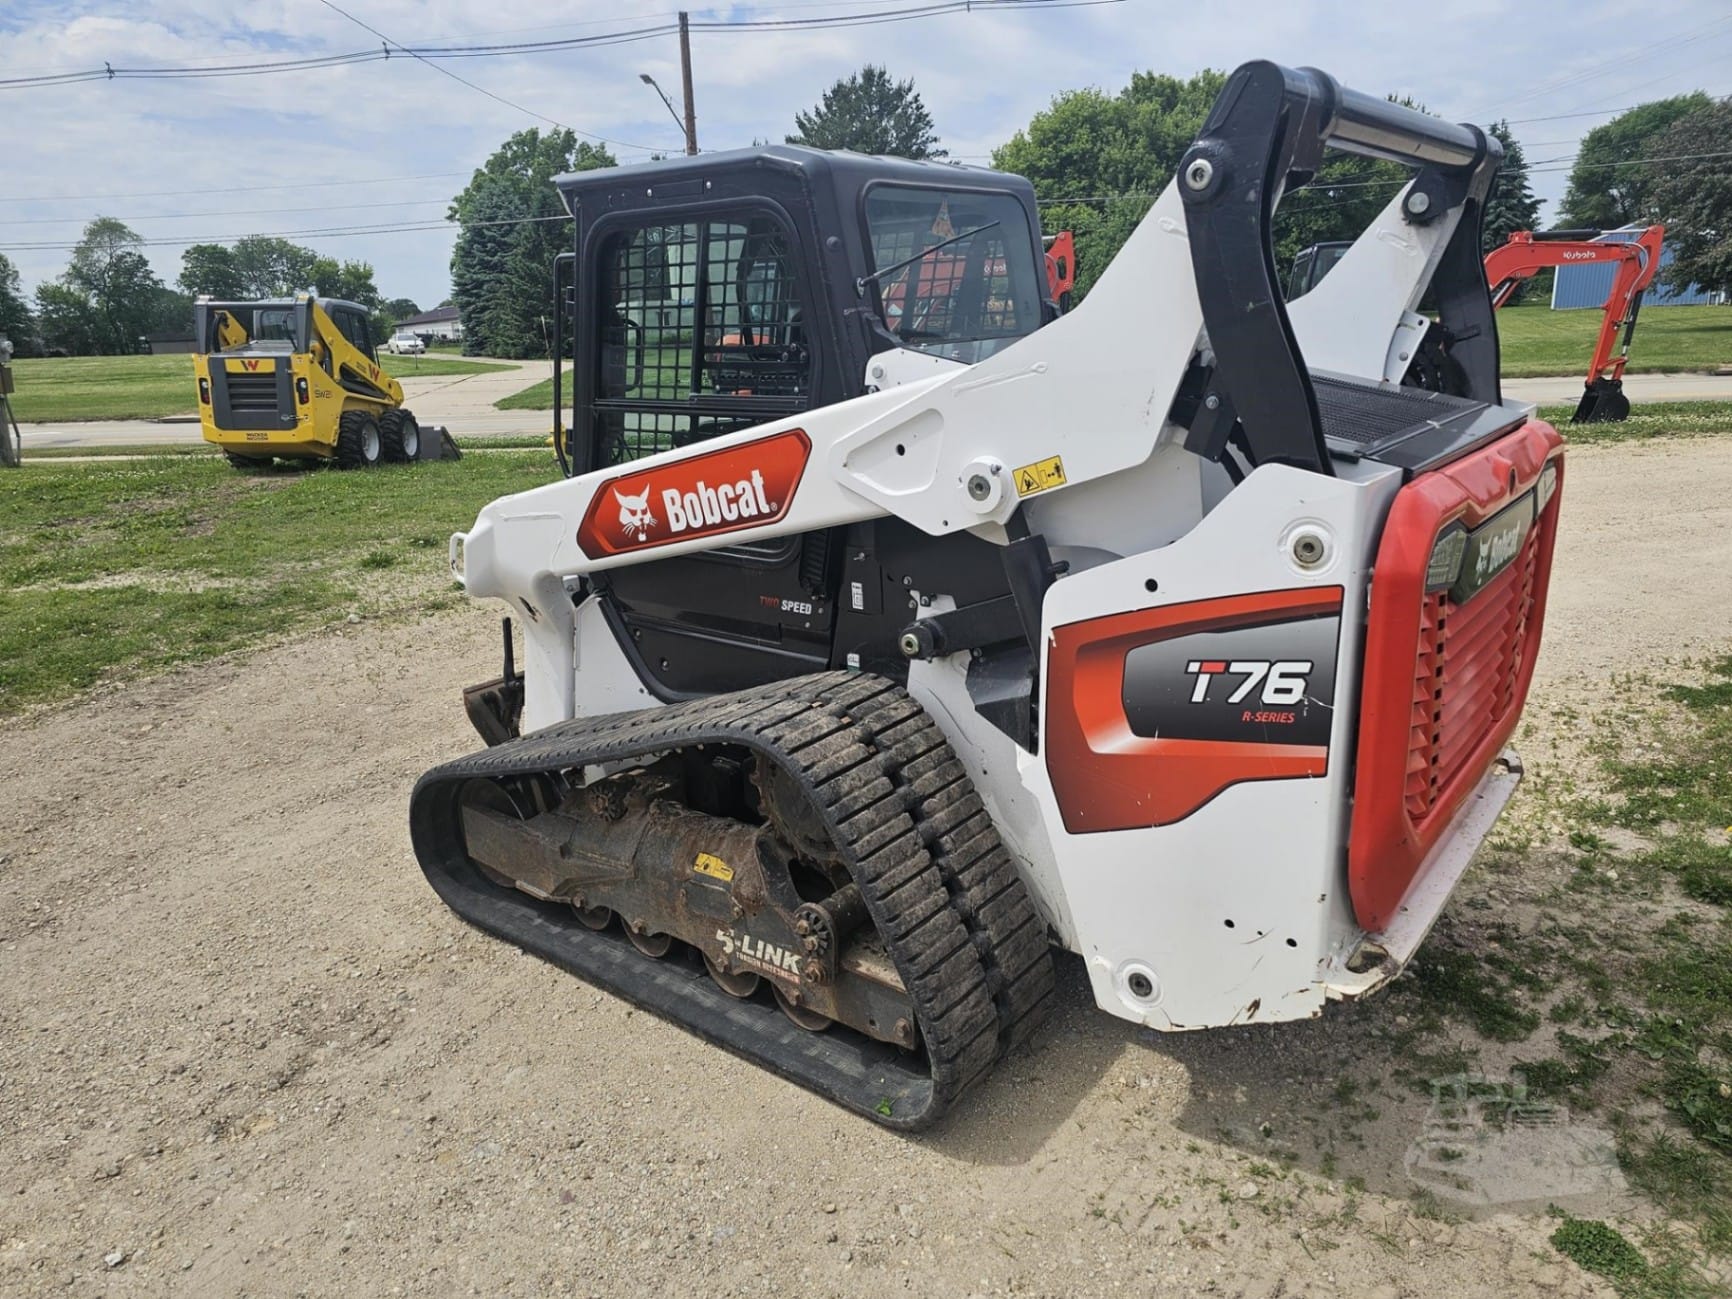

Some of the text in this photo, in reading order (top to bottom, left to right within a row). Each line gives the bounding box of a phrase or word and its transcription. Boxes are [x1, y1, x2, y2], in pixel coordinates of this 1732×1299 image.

[662, 469, 771, 533] Bobcat
[781, 600, 812, 615] SPEED
[1185, 660, 1313, 705] T76
[1242, 711, 1295, 723] R-SERIES
